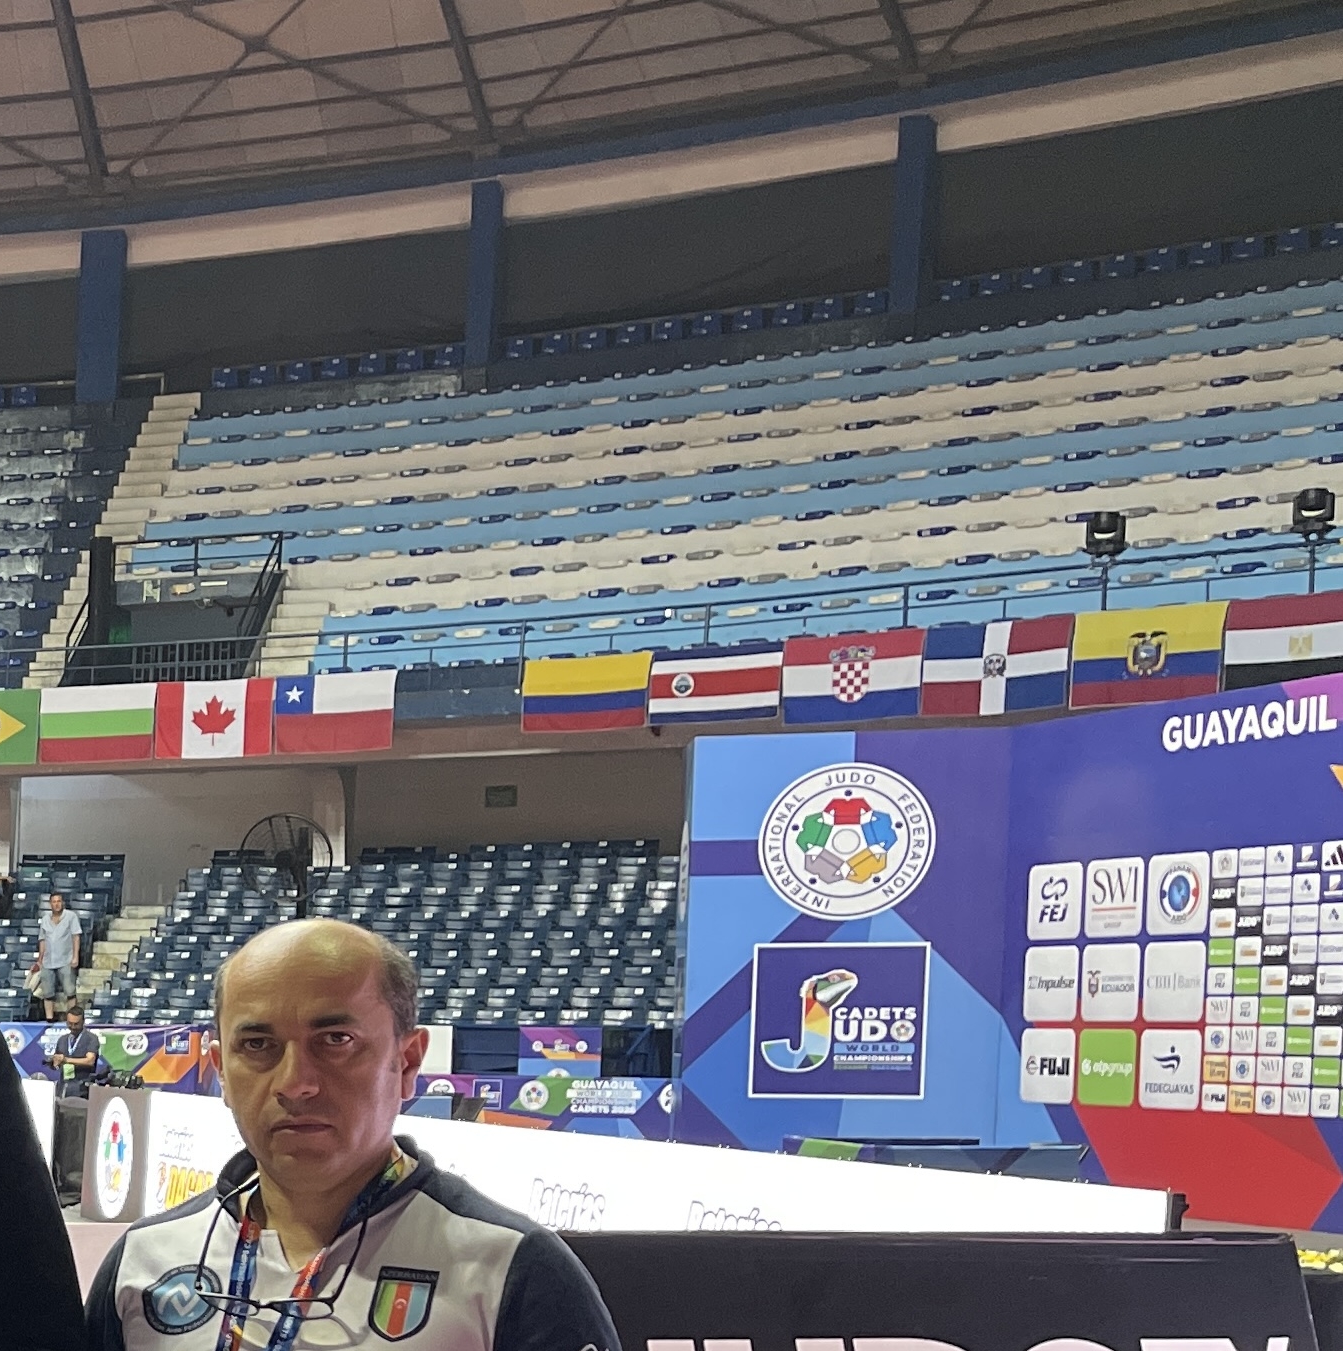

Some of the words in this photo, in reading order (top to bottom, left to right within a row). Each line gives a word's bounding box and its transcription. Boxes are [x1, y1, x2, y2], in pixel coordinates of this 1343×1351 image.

[1162, 694, 1338, 753] GUAYAQUIL
[769, 793, 830, 910] INTERNATIONAL
[824, 772, 876, 787] JUDO
[882, 793, 926, 898] FEDERATION
[1091, 866, 1139, 905] SWI
[1038, 903, 1069, 924] FEJ
[835, 1006, 917, 1020] CADETS
[845, 1043, 900, 1053] WORLD
[833, 1054, 913, 1063] CHAMPIONSHIPS
[1039, 1057, 1071, 1076] FUJI
[571, 1079, 638, 1090] GUAYAQUIL
